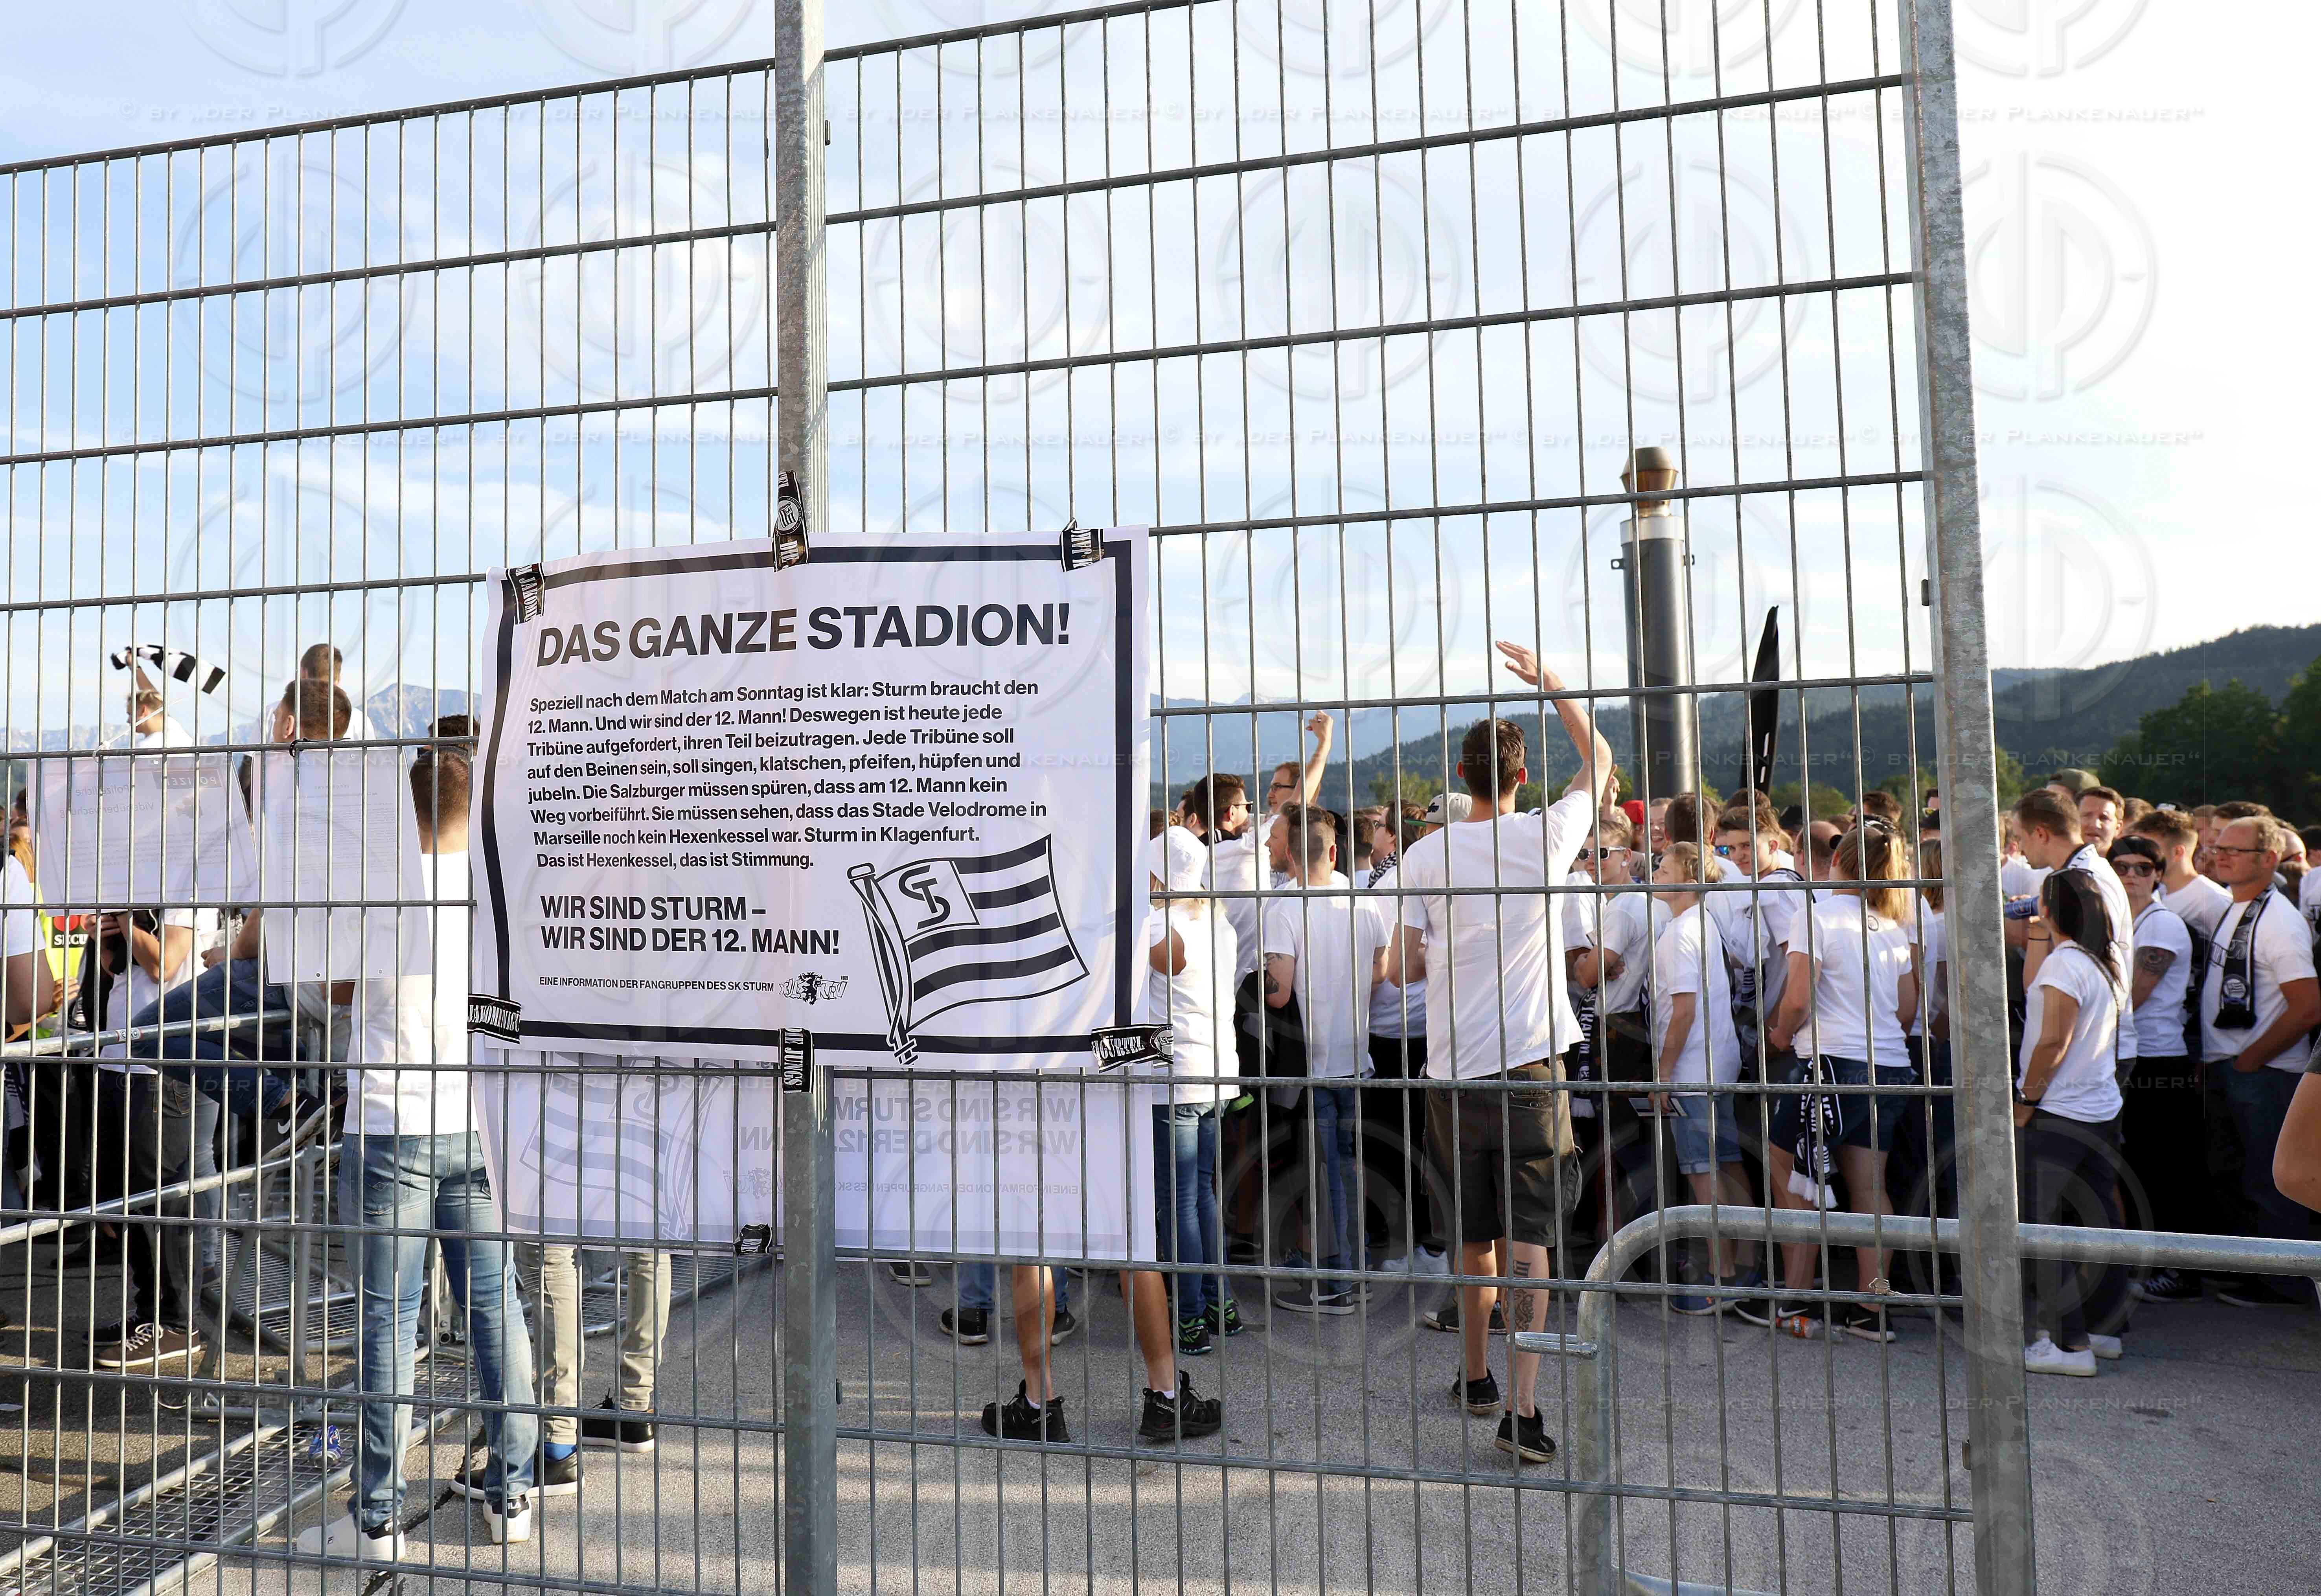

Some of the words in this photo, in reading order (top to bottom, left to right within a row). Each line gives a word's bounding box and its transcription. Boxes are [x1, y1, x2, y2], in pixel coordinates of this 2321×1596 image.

[537, 621, 620, 667] DAS
[629, 608, 797, 659] GANZE
[807, 603, 1069, 650] STADION!
[530, 695, 583, 714] Speziell
[586, 693, 622, 708] nach
[625, 691, 658, 706] dem
[661, 688, 707, 704] Match
[710, 691, 734, 702] am
[737, 685, 803, 702] Sonntag
[807, 683, 827, 698] ist
[831, 682, 868, 697] klar:
[872, 682, 927, 697] Sturm
[931, 680, 1000, 696] braucht
[1004, 680, 1038, 695] den
[528, 720, 546, 734] 12.
[549, 719, 593, 733] Mann.
[595, 715, 627, 731] Und
[629, 714, 652, 729] wir
[654, 712, 683, 728] sind
[686, 712, 712, 726] der
[715, 711, 735, 725] 12.
[738, 708, 786, 724] Mann!
[790, 708, 880, 724] Deswegen
[884, 706, 905, 721] ist
[909, 705, 960, 720] heute
[962, 704, 1002, 723] jede
[527, 741, 583, 756] Tribüne
[586, 737, 680, 756] aufgefordert,
[684, 735, 722, 750] ihren
[725, 733, 752, 748] Teil
[755, 732, 859, 749] beizutragen.
[863, 729, 907, 745] Jede
[910, 729, 979, 744] Tribüne
[982, 728, 1013, 743] soll
[528, 764, 551, 779] auf
[554, 764, 583, 778] den
[585, 761, 638, 776] Beinen
[640, 760, 670, 777] sein,
[673, 758, 699, 774] soll
[701, 758, 757, 776] singen,
[760, 755, 846, 773] klatschen,
[850, 754, 916, 772] pfeifen,
[919, 753, 982, 771] hüpfen
[986, 752, 1020, 768] und
[528, 786, 580, 805] jubeln.
[582, 785, 608, 799] Die
[610, 783, 685, 800] Salzburger
[688, 782, 749, 796] müssen
[751, 780, 811, 798] spüren,
[814, 779, 855, 794] dass
[858, 782, 886, 793] am
[889, 778, 912, 793] 12.
[917, 777, 966, 792] Mann
[969, 777, 1007, 792] kein
[530, 809, 566, 826] Weg
[568, 807, 649, 822] vorbeiführt.
[651, 806, 674, 821] Sie
[677, 805, 737, 820] müssen
[740, 804, 793, 822] sehen,
[796, 803, 834, 818] dass
[837, 803, 869, 818] das
[872, 802, 925, 818] Stade
[927, 802, 1027, 817] Velodrome
[1031, 801, 1046, 816] in
[533, 830, 601, 845] Marseille
[603, 829, 635, 844] noch
[638, 829, 666, 844] kein
[669, 827, 769, 844] Hexenkessel
[771, 831, 801, 842] war.
[804, 827, 857, 842] Sturm
[861, 827, 876, 842] in
[881, 826, 979, 845] Klagenfurt.
[537, 853, 565, 867] Das
[568, 853, 584, 867] ist
[587, 852, 677, 870] Hexenkessel,
[680, 852, 708, 867] das
[710, 852, 728, 867] ist
[731, 851, 814, 870] Stimmung.
[540, 895, 585, 919] WIR
[589, 895, 646, 920] SIND
[651, 896, 747, 921] STURM
[541, 926, 585, 949] WIR
[589, 927, 647, 951] SIND
[652, 928, 707, 952] DER
[712, 929, 746, 952] 12.
[752, 929, 839, 954] MANN!
[540, 976, 558, 986] EINE
[559, 977, 618, 988] INFORMATION
[620, 979, 638, 989] DER
[640, 980, 705, 989] FANGRUPPEN
[707, 981, 726, 990] DES
[728, 981, 741, 991] SK
[743, 982, 774, 992] STURM
[783, 1047, 803, 1086] JUNGS
